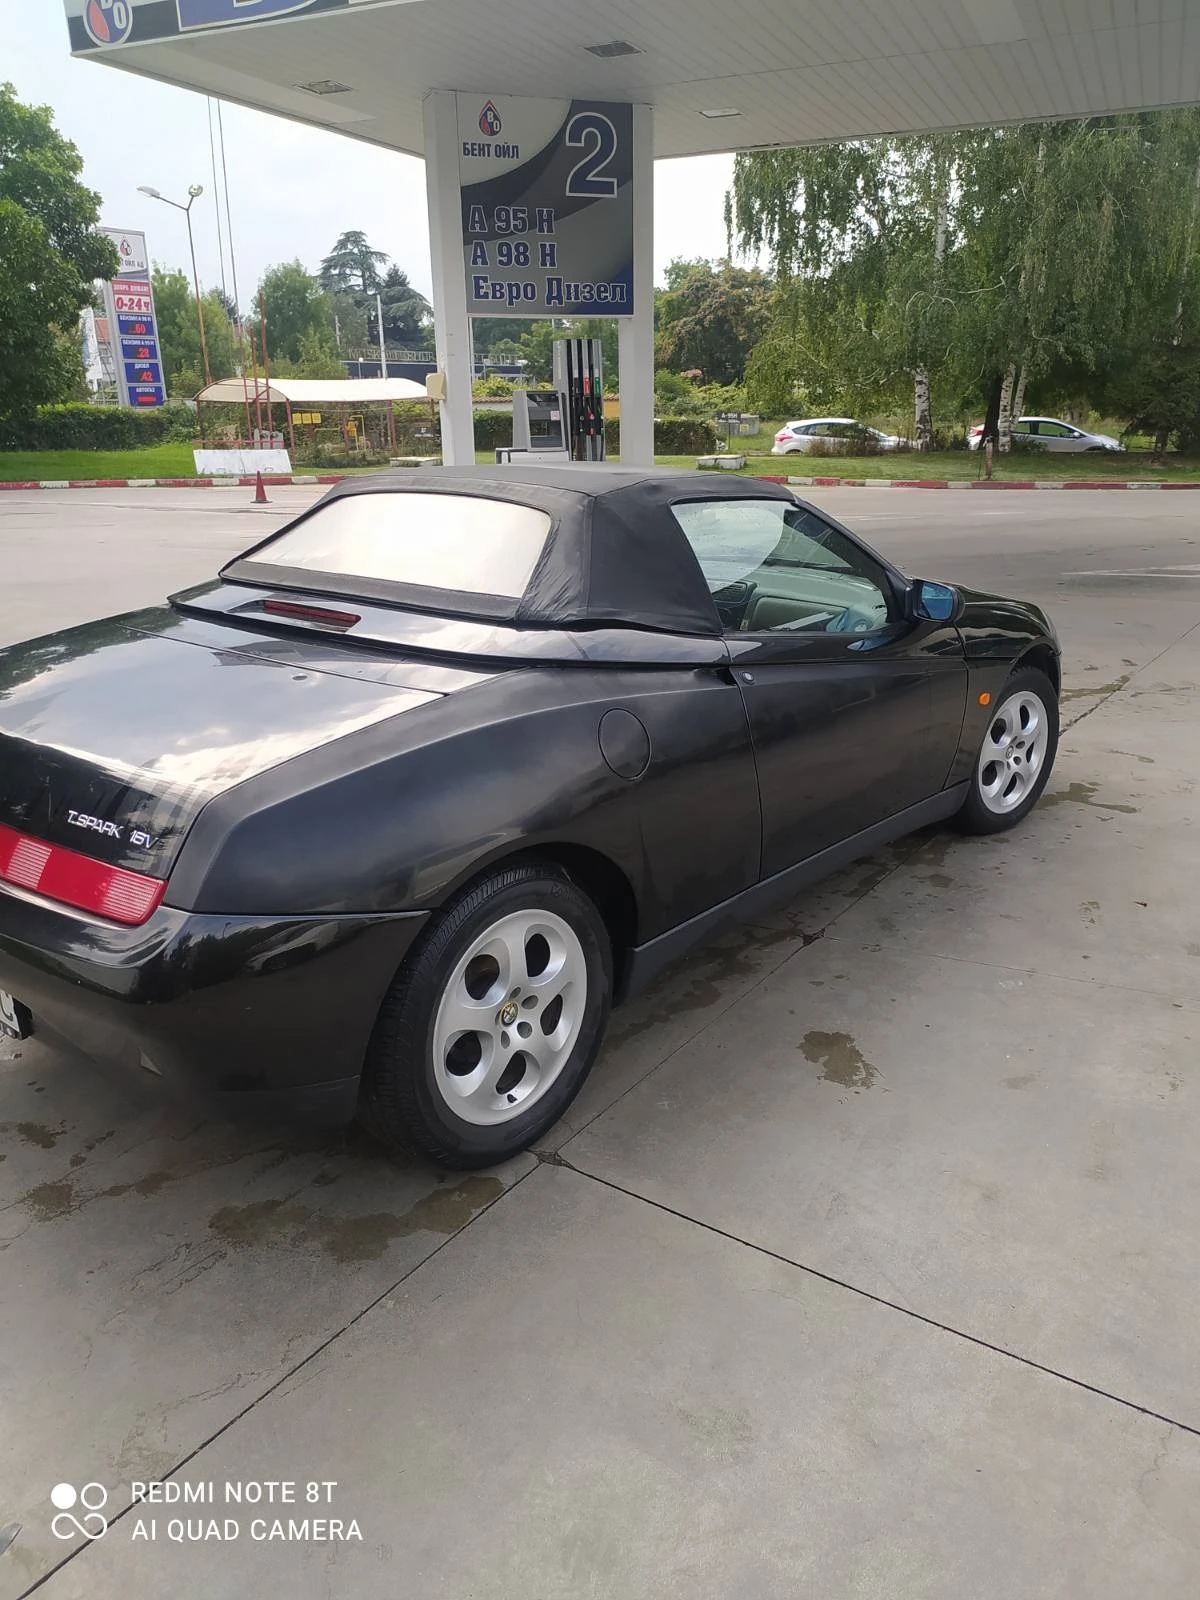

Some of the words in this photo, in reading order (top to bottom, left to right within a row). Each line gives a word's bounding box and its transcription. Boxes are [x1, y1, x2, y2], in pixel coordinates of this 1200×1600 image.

[462, 142, 492, 158] БЕНТ
[494, 141, 520, 160] ОЙЛ
[565, 111, 618, 198] 2
[468, 205, 488, 232] А
[495, 206, 529, 234] 95
[536, 208, 555, 235] Н
[470, 240, 489, 266] А
[497, 241, 530, 267] 98
[539, 242, 558, 268] Н
[472, 275, 537, 307] Евро
[545, 276, 627, 306] Дизел
[67, 809, 125, 839] T.SPARK
[129, 830, 159, 850] 16V
